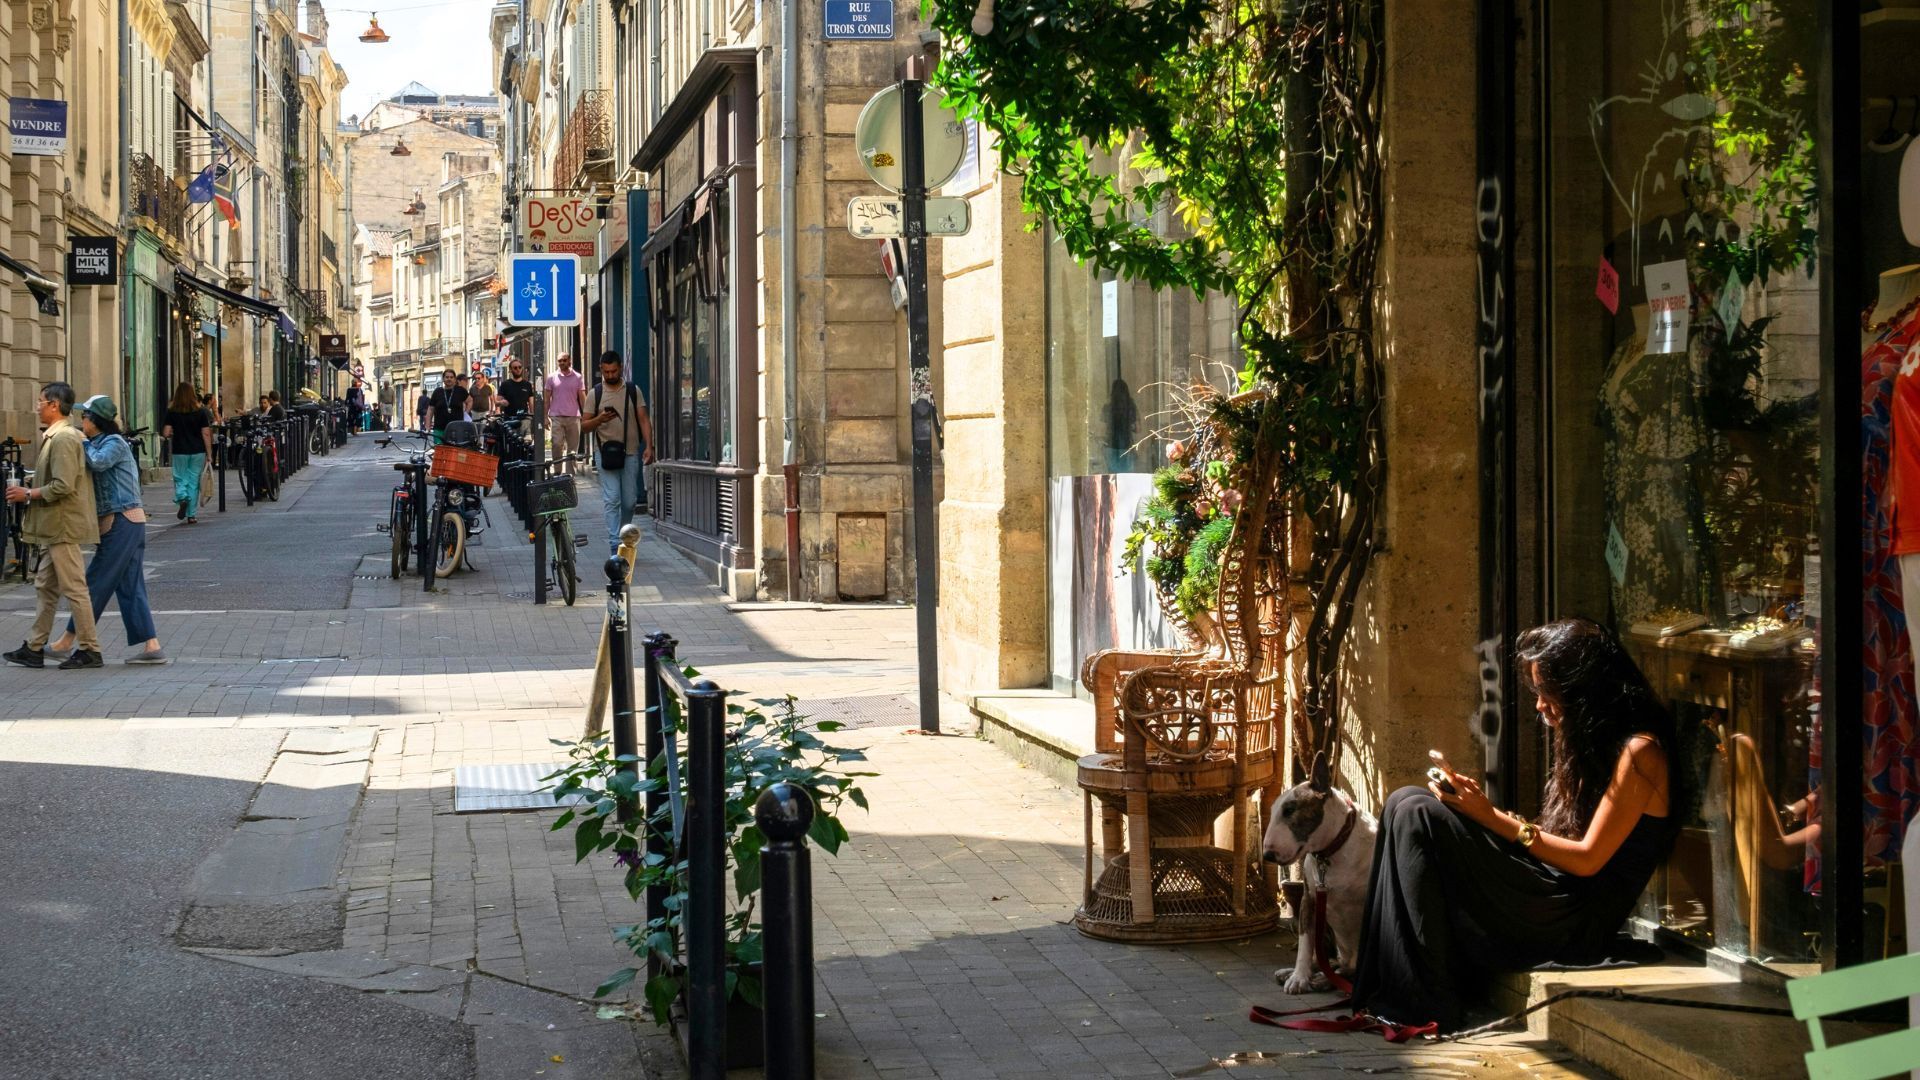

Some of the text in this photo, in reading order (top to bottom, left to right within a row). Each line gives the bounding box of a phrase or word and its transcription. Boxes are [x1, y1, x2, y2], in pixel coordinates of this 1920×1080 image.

[849, 2, 870, 12] RUE
[827, 24, 891, 34] TROIS CONILS
[12, 120, 61, 131] VENDRE
[78, 258, 106, 267] MILK
[1651, 296, 1686, 313] BRADERIE
